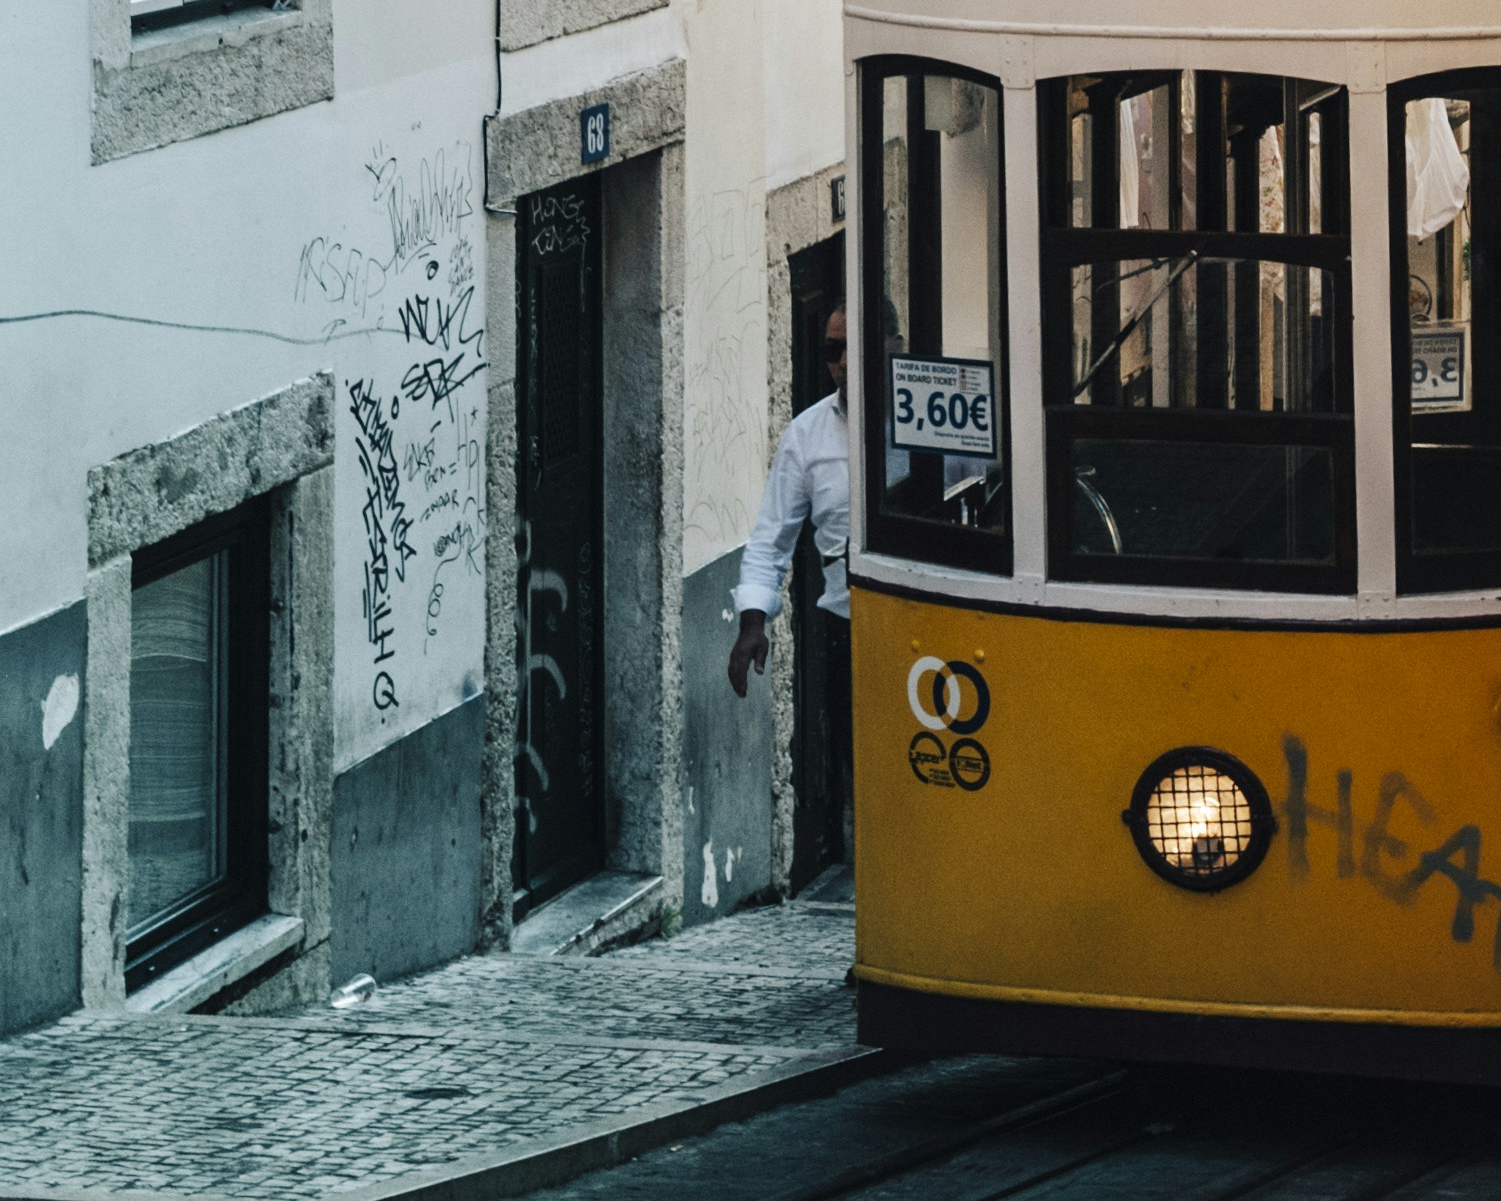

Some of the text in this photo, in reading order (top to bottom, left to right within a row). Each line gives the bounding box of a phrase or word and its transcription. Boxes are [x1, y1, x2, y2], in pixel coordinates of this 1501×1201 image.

[587, 113, 604, 154] 68
[895, 362, 957, 375] TARIFA DE BORDO
[896, 373, 906, 381] ON
[907, 374, 932, 384] BOARD
[933, 376, 957, 386] TICKET
[896, 388, 988, 431] 3,60€
